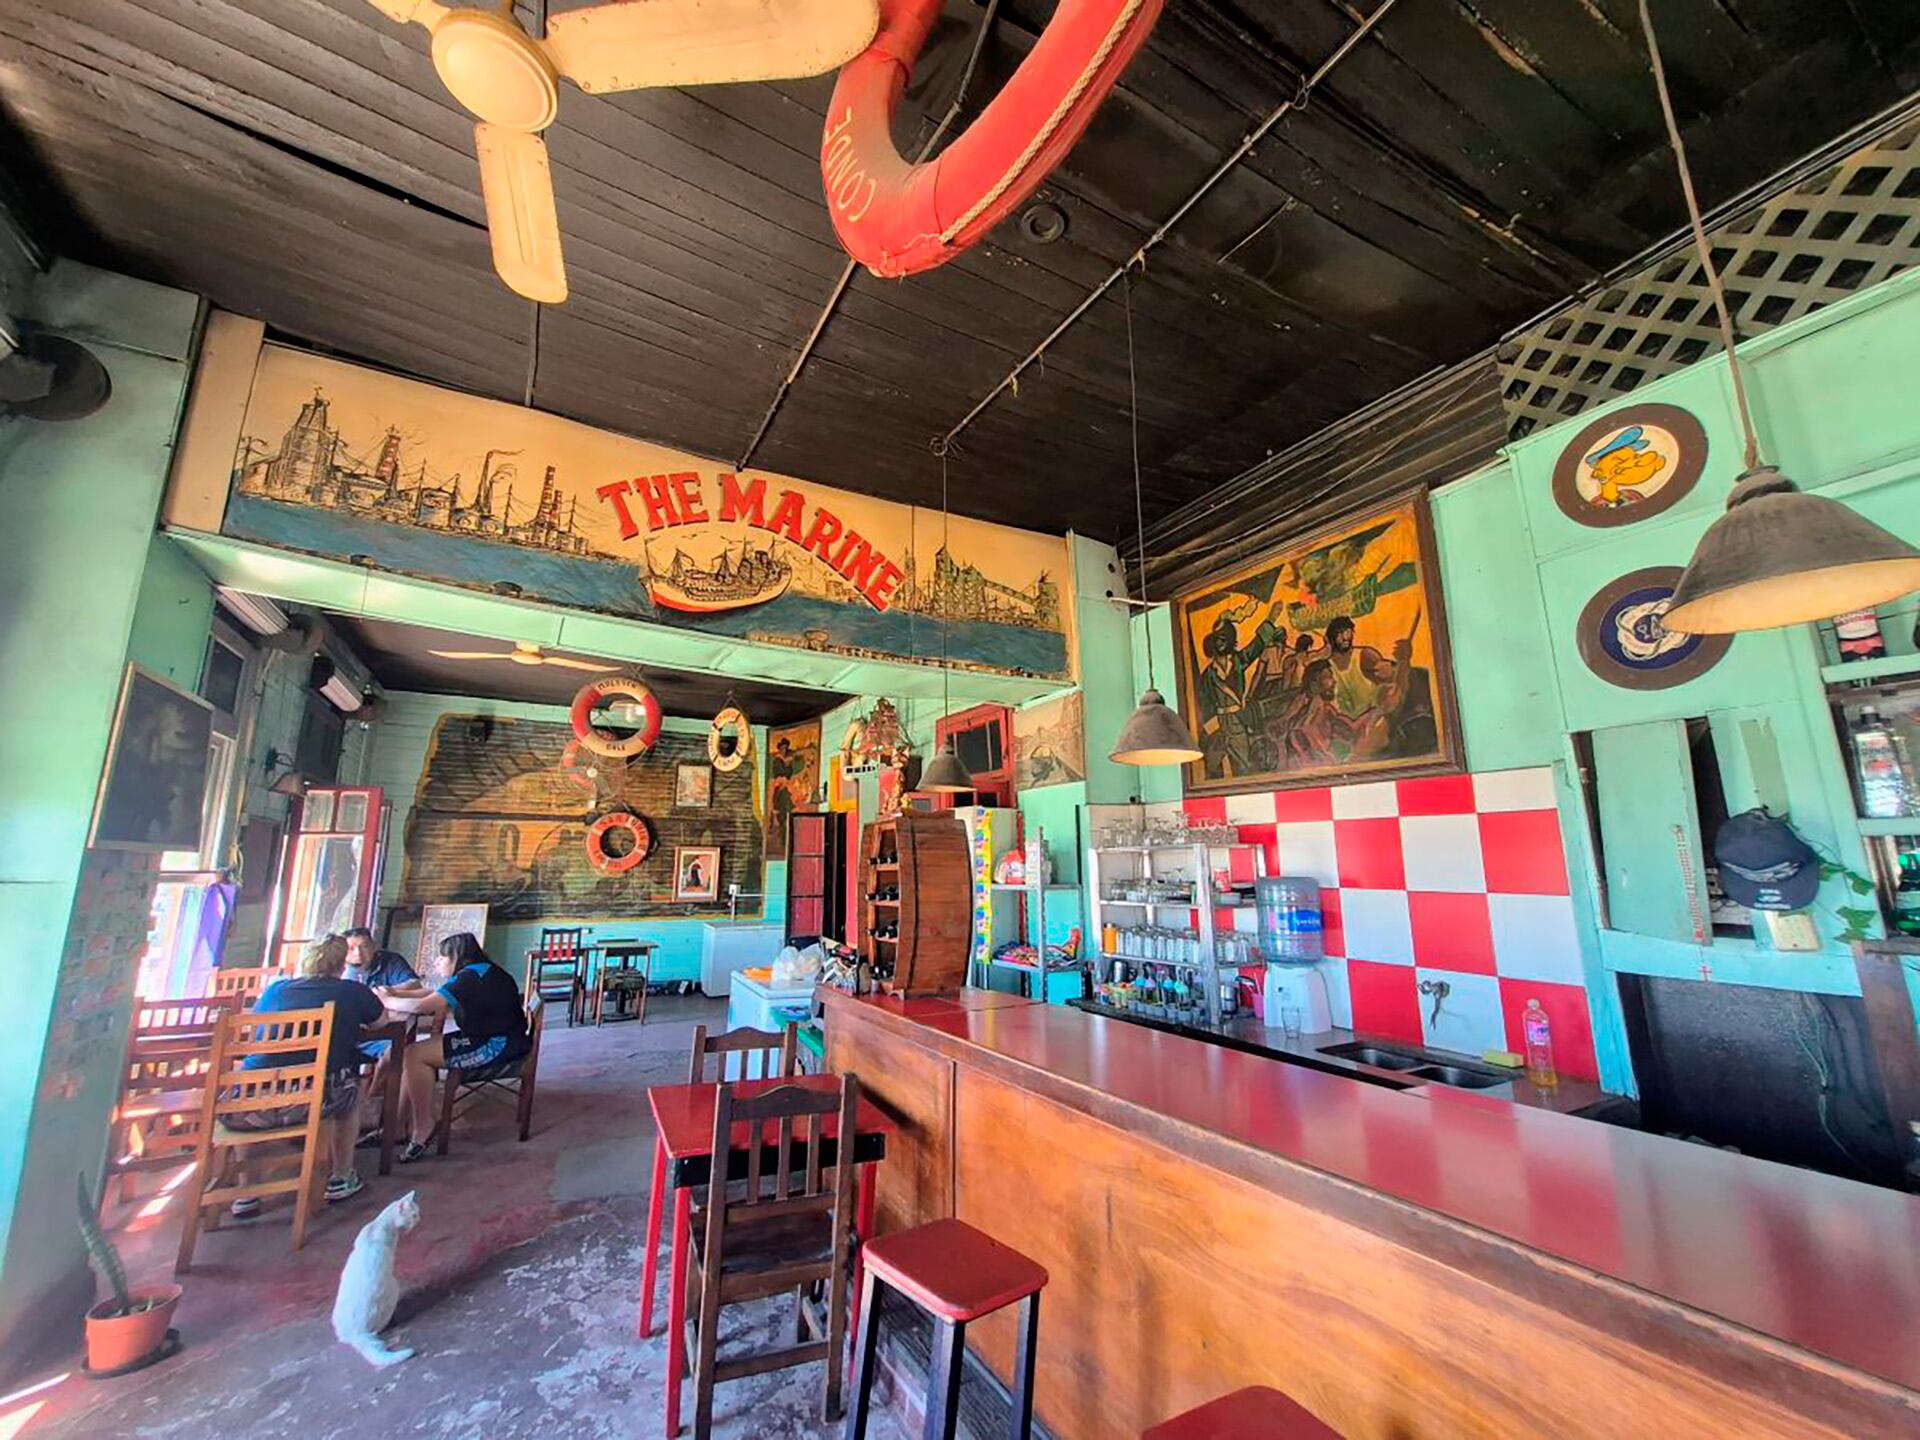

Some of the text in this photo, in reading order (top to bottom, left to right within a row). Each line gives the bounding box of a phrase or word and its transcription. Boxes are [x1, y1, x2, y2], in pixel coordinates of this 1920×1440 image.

[822, 106, 877, 223] CONDE
[596, 471, 907, 613] THE MARINE
